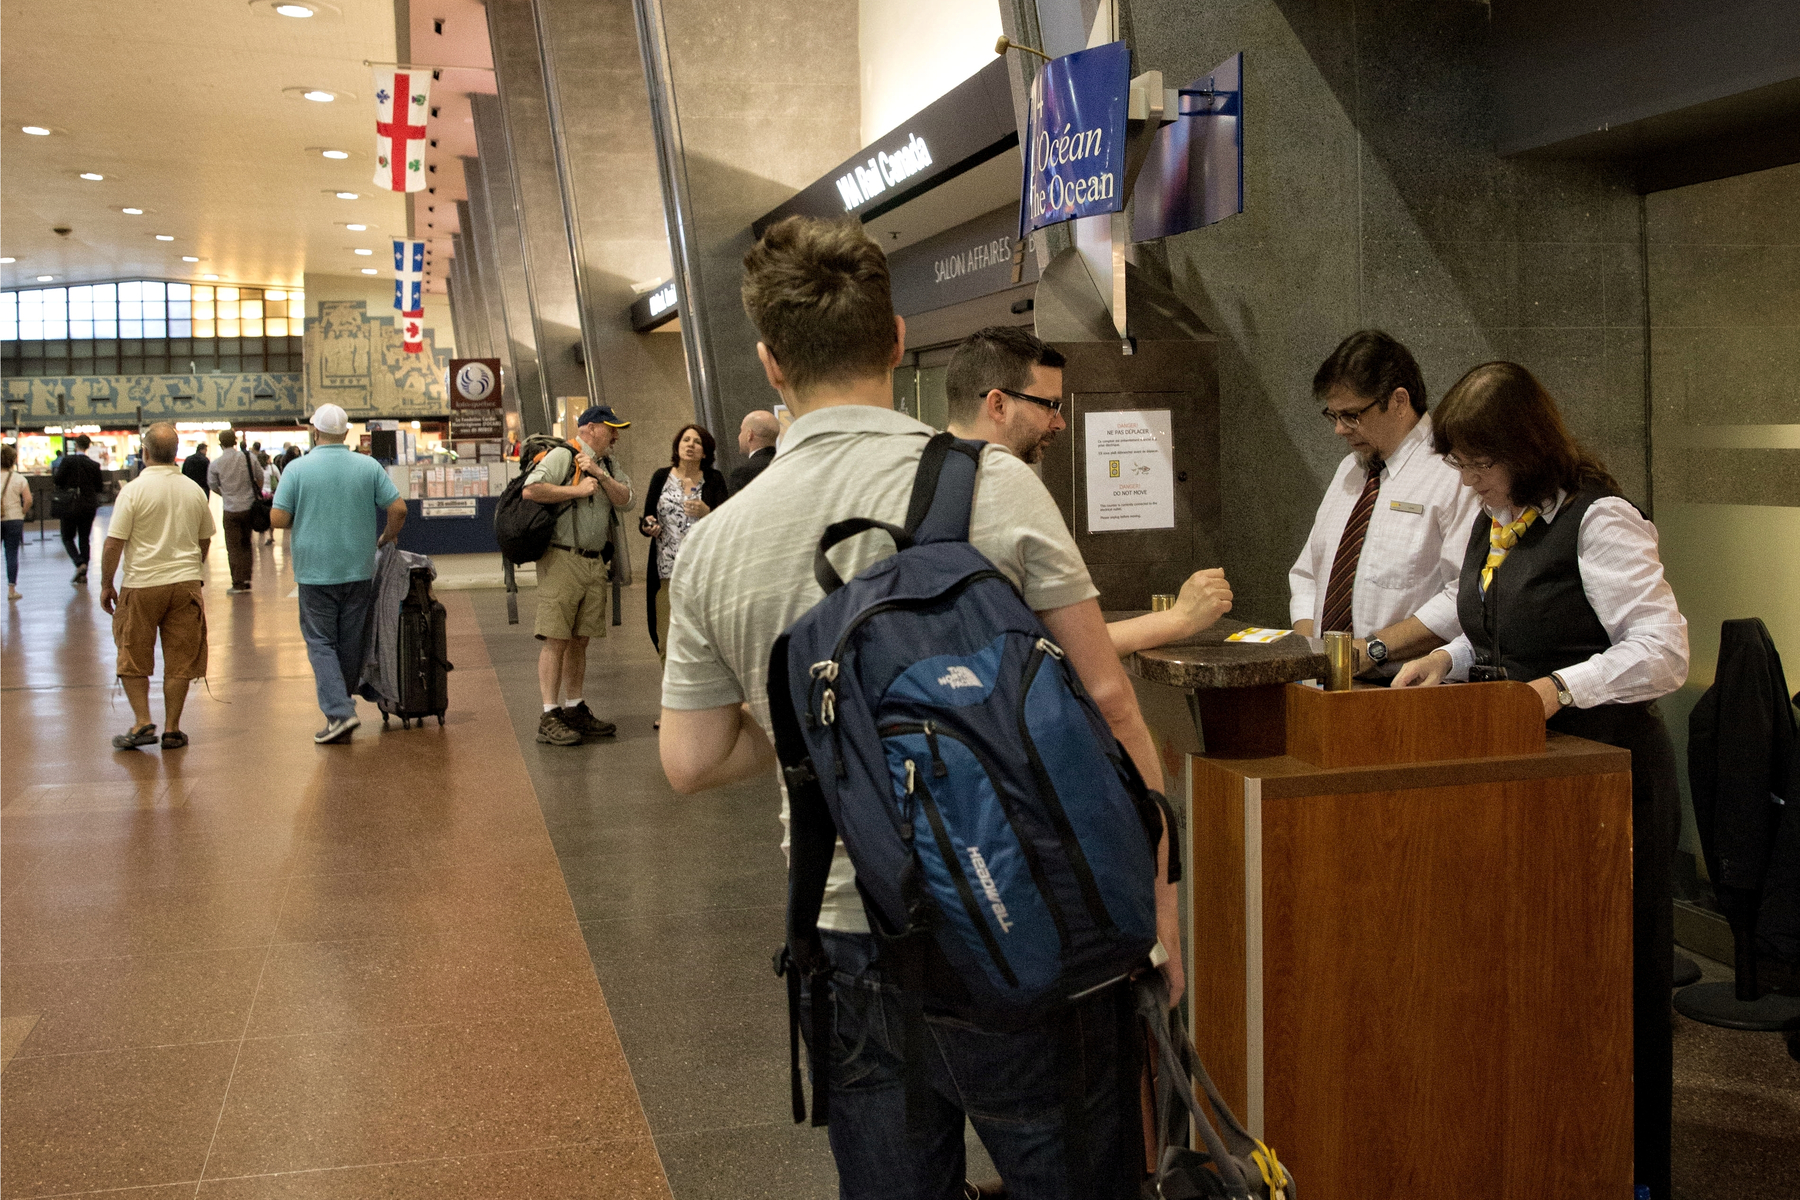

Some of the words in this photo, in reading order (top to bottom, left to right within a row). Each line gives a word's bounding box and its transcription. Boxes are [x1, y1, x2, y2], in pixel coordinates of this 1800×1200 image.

[854, 157, 886, 200] Rail
[878, 132, 933, 187] Canada
[1050, 172, 1114, 211] Ocean
[934, 252, 966, 283] SALON
[967, 236, 1011, 273] AFFAIRES
